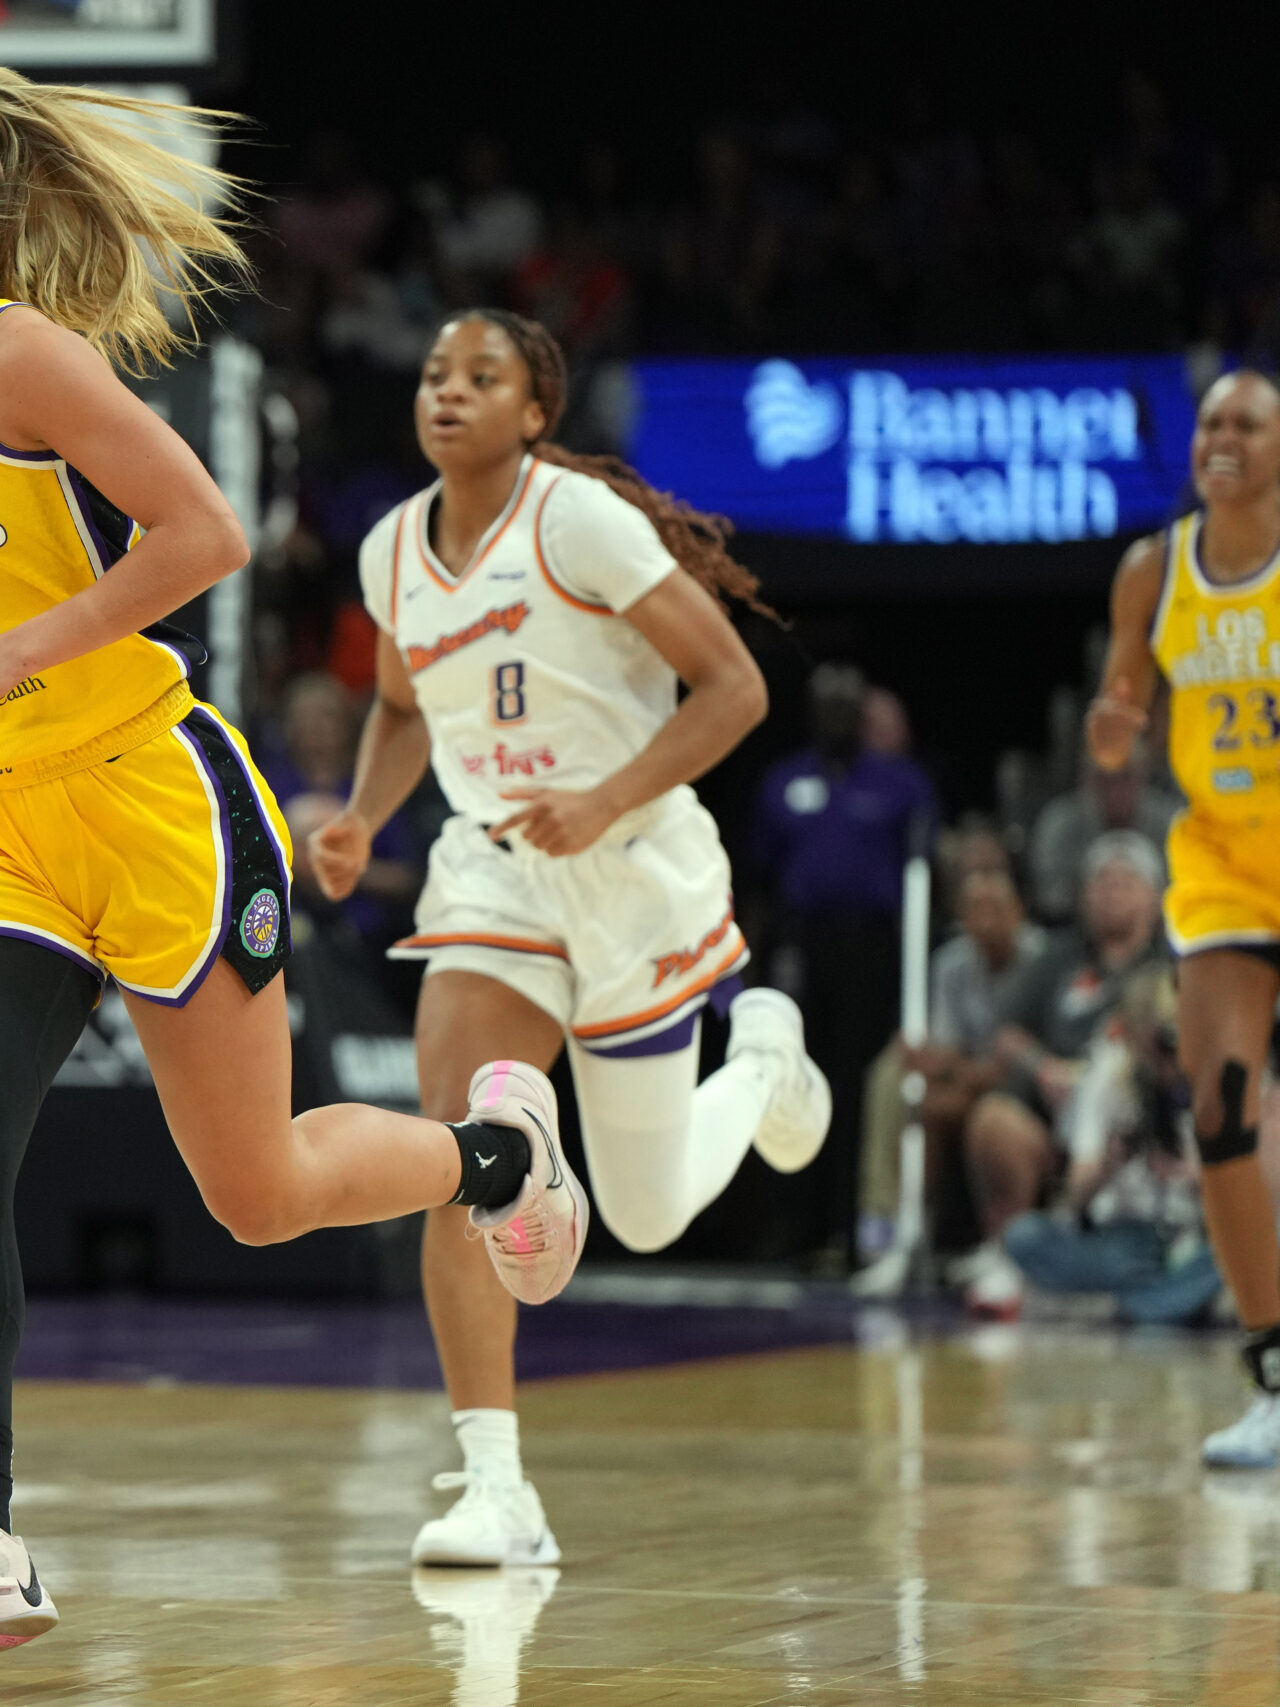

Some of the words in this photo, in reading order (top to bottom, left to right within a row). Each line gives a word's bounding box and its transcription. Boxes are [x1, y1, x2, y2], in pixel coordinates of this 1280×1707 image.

[846, 450, 1118, 545] Health
[490, 661, 527, 728] 8
[1207, 689, 1280, 753] 23
